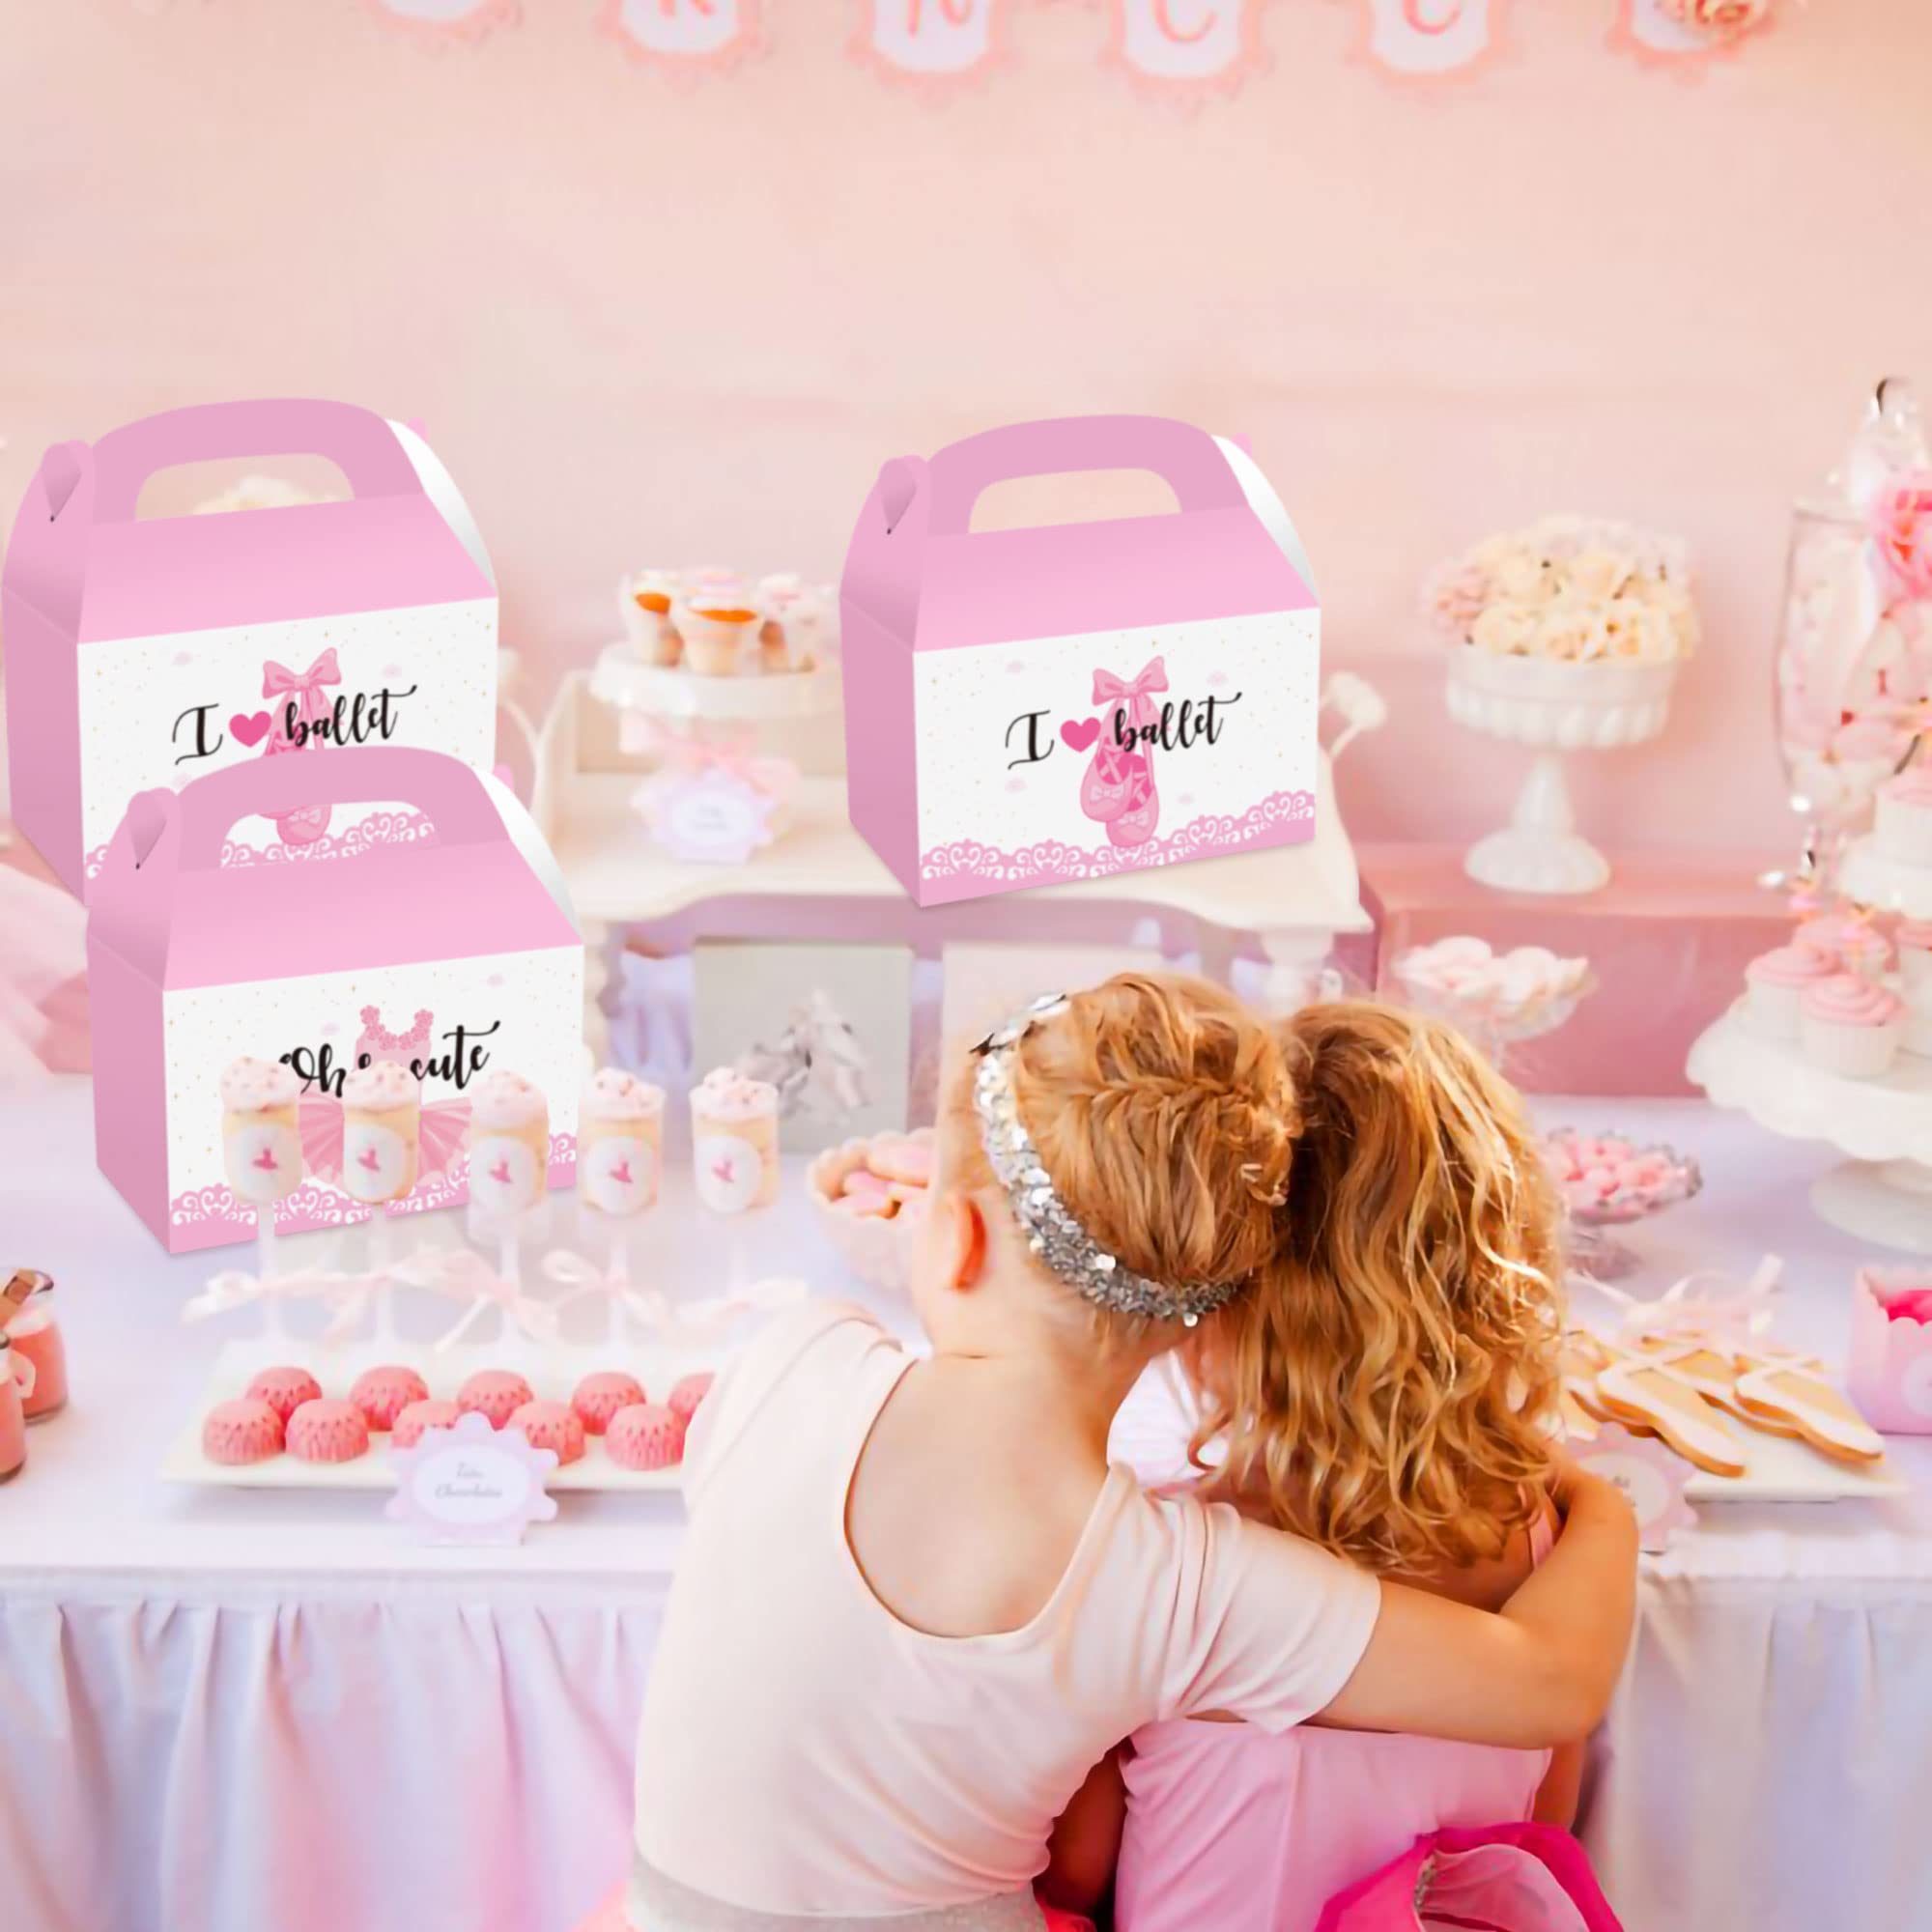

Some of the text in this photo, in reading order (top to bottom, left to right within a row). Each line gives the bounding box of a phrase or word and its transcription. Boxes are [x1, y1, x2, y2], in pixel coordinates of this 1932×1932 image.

[171, 684, 417, 765] I ballet
[1006, 691, 1242, 770] I ballet
[278, 1042, 348, 1098] Oh
[410, 1020, 501, 1091] cute
